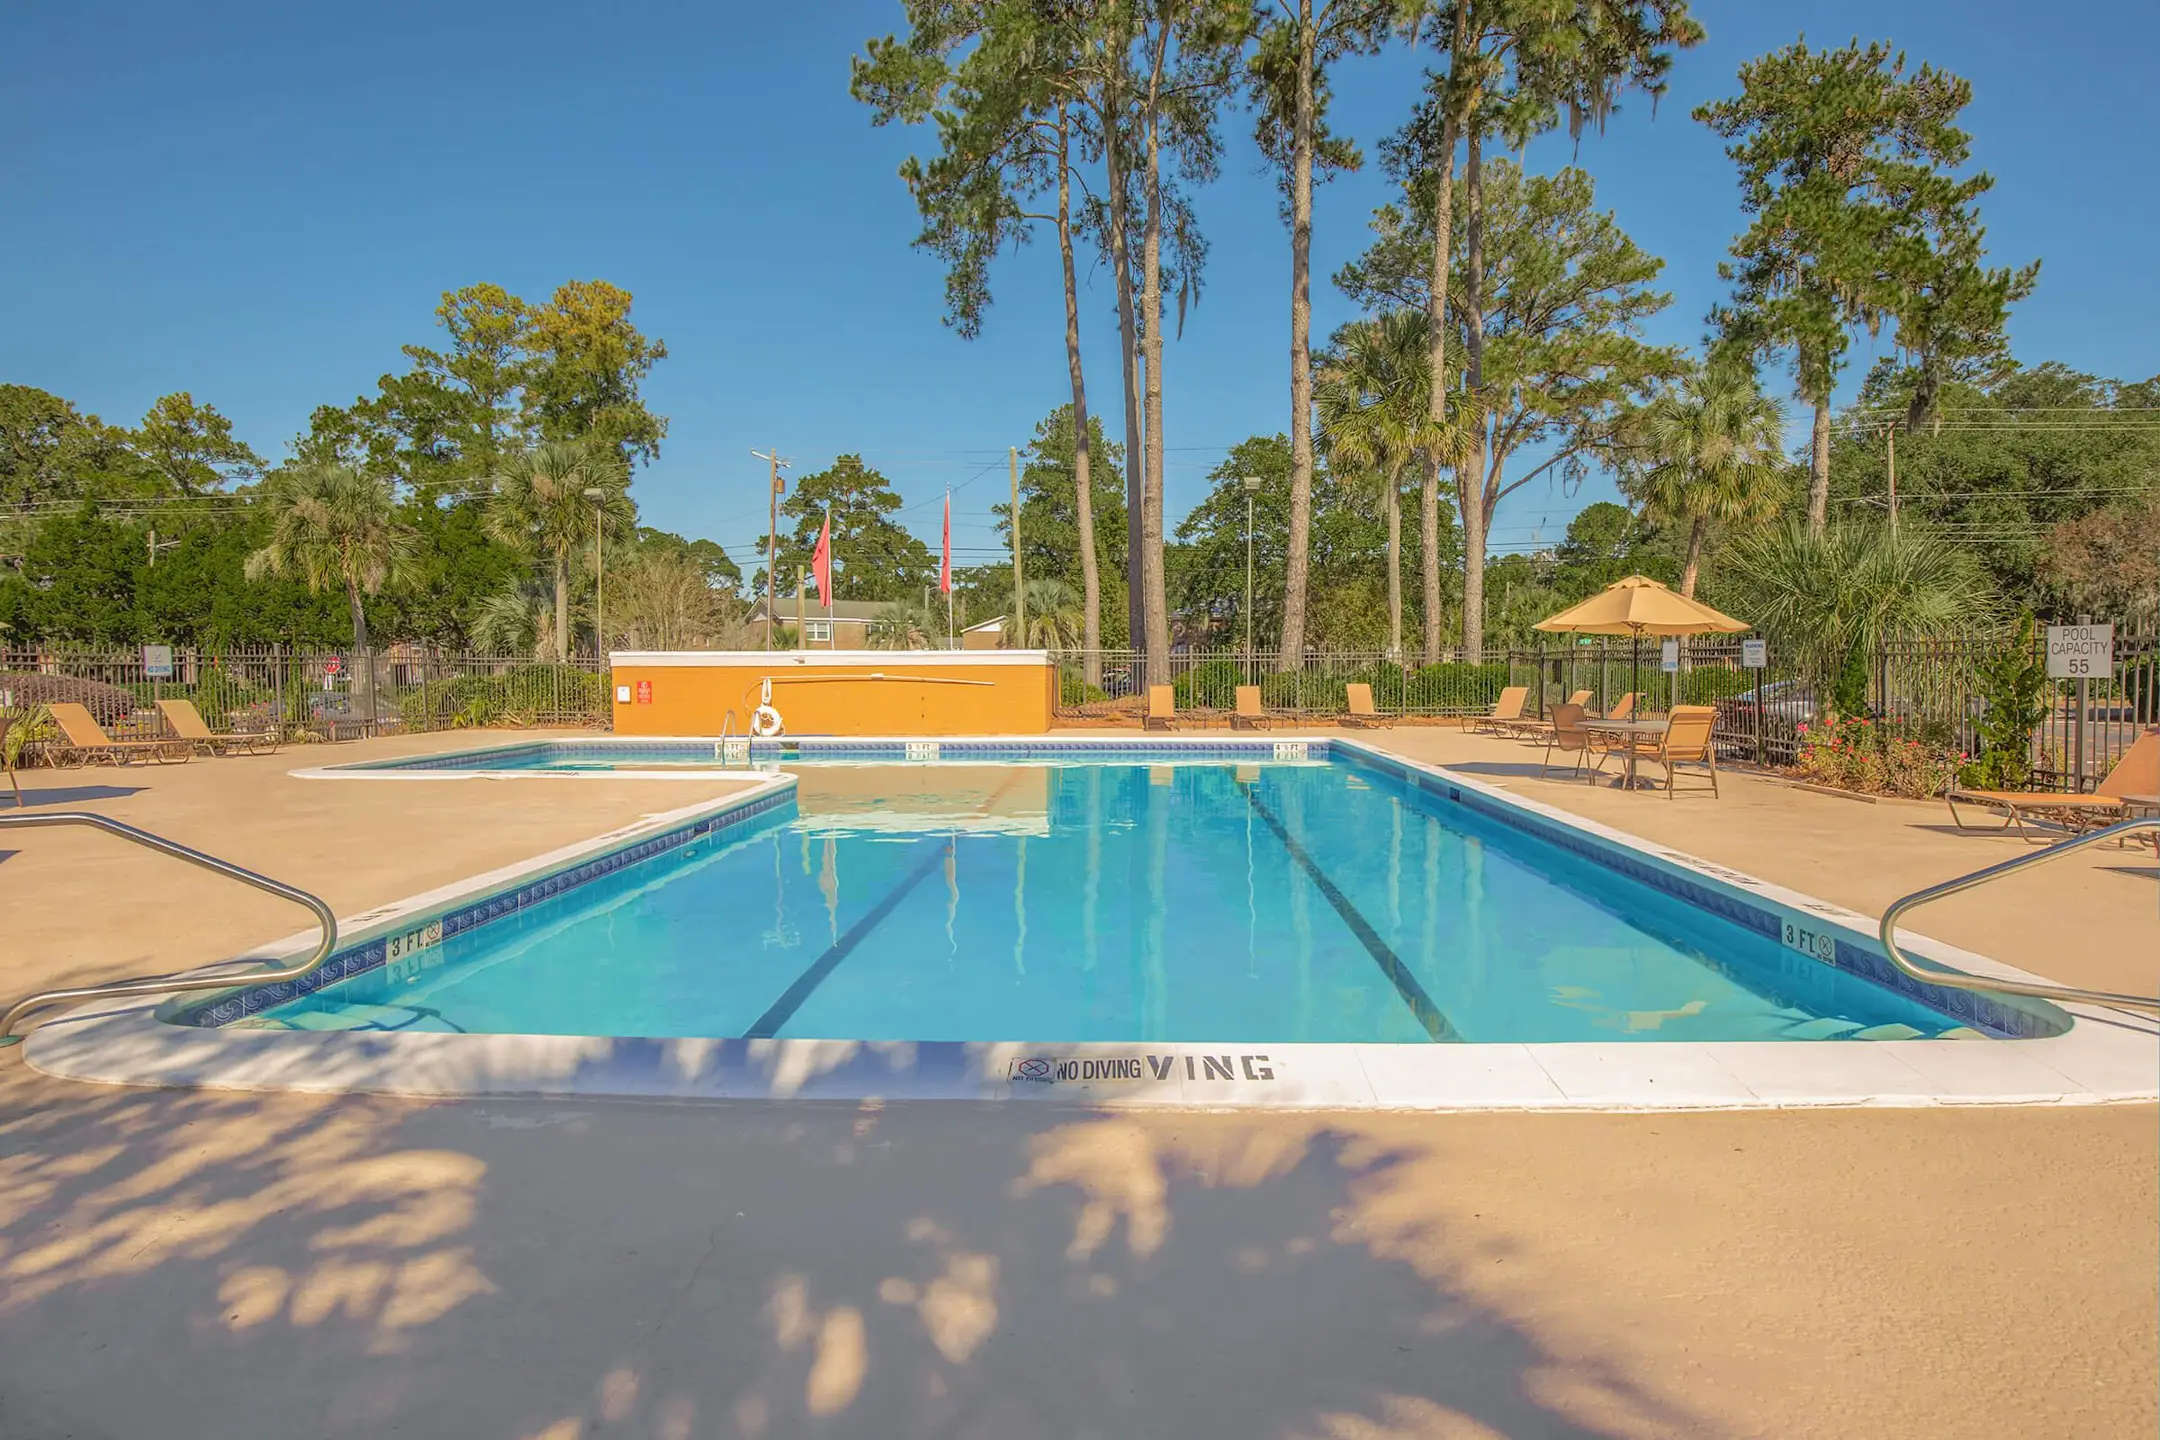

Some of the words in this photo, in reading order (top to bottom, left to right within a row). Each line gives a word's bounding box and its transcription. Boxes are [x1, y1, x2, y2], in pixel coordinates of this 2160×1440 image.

[2062, 627, 2096, 641] POOL
[2051, 641, 2108, 655] CAPACITY
[2069, 658, 2089, 674] 55
[1786, 924, 1794, 944] 3
[392, 936, 400, 957] 3
[1057, 1060, 1079, 1081] NO
[1083, 1060, 1141, 1080] DIVING
[1146, 1055, 1275, 1081] VING
